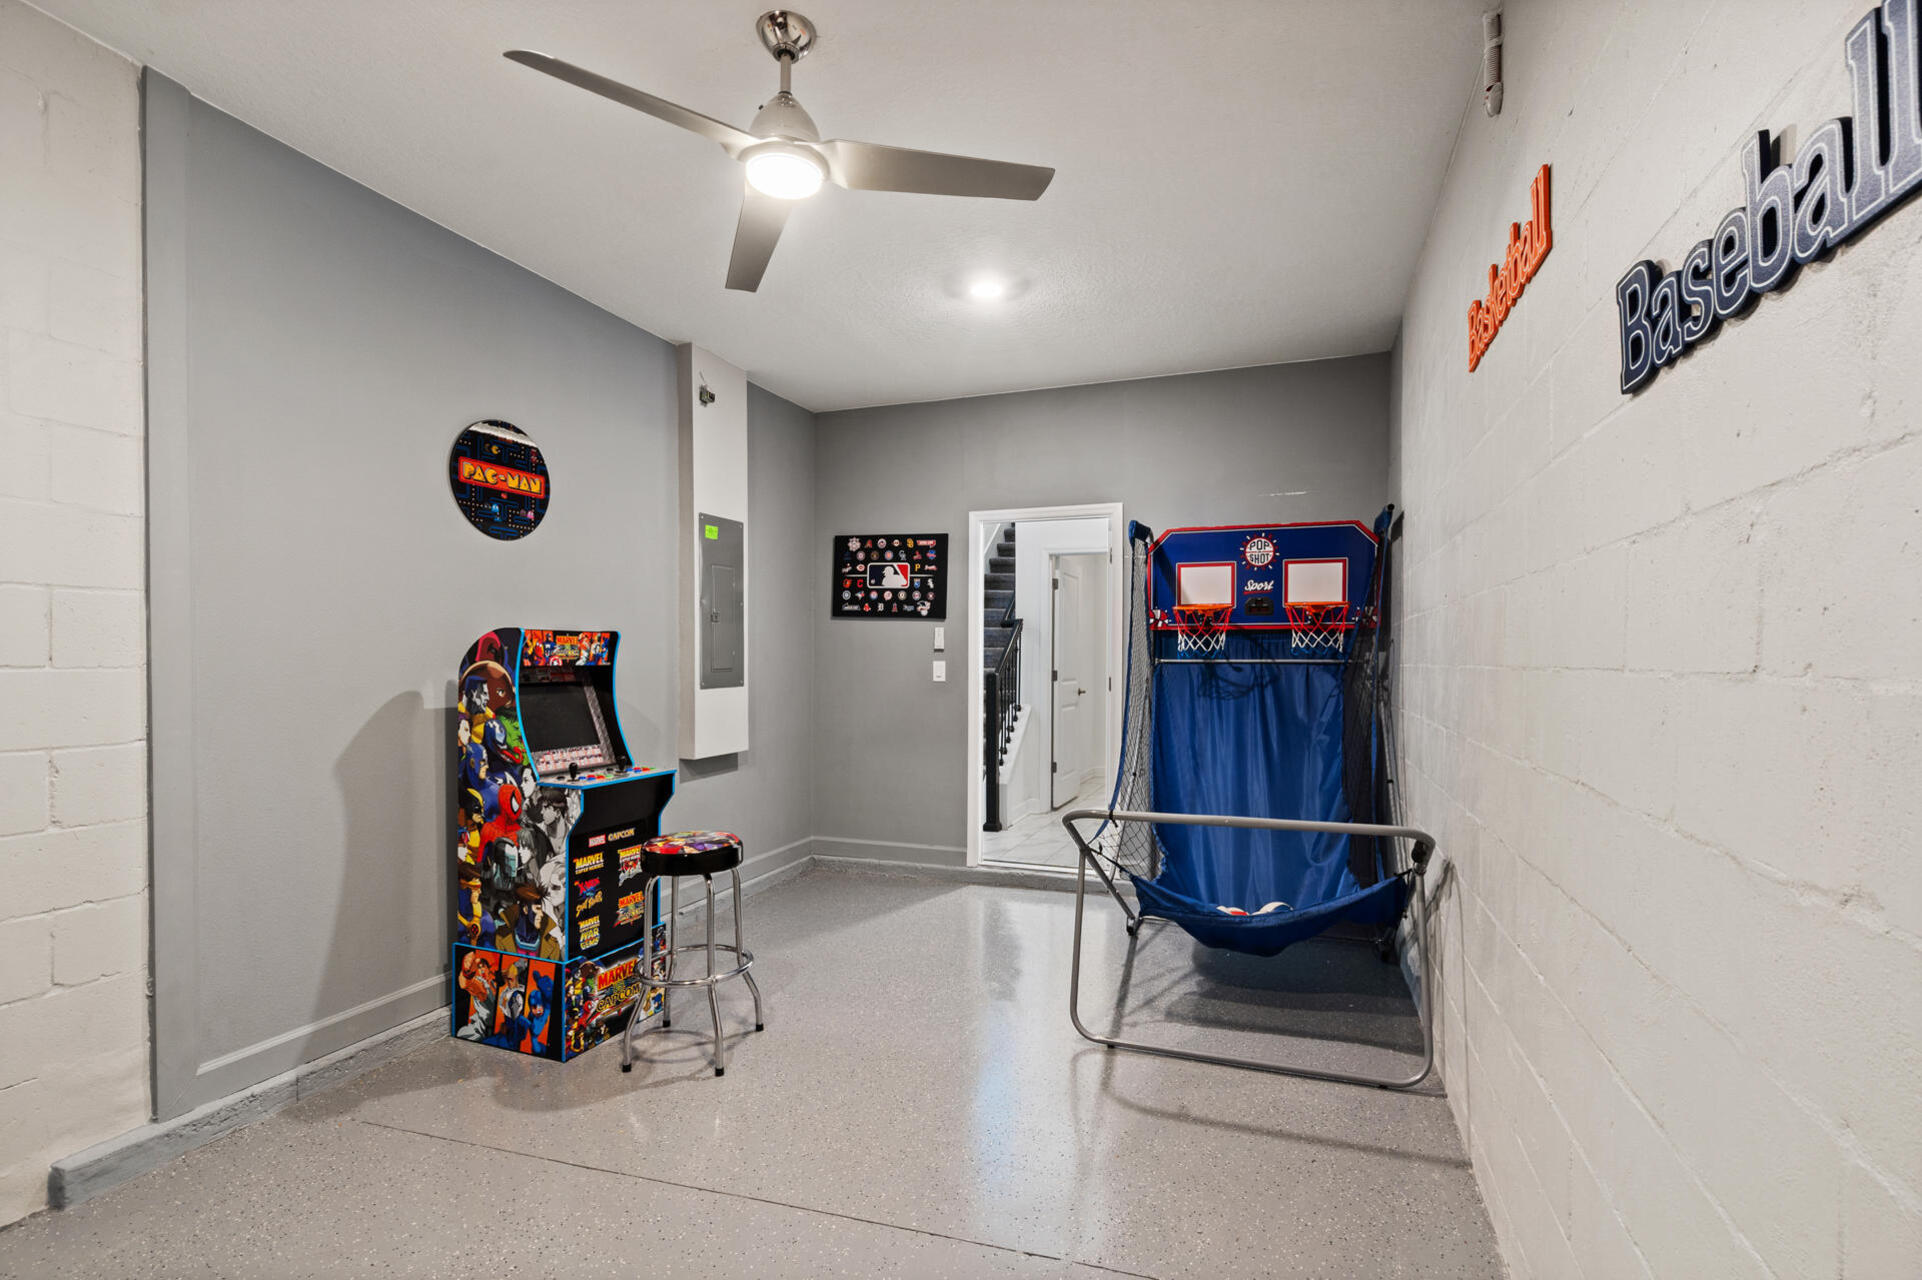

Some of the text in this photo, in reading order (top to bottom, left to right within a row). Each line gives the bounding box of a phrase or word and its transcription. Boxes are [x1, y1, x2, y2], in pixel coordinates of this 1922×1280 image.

[1617, 0, 1922, 393] Baseball
[1468, 164, 1551, 372] Basketball
[462, 461, 541, 494] PAC-MAN
[1249, 540, 1270, 550] POP
[1249, 553, 1270, 564] SHOT
[1244, 580, 1274, 591] Sport
[608, 828, 635, 841] CAPCOM
[575, 852, 604, 868] MARVEL
[580, 927, 599, 943] WAR
[597, 957, 638, 991] MARVE
[596, 981, 641, 1012] CAPCOM
